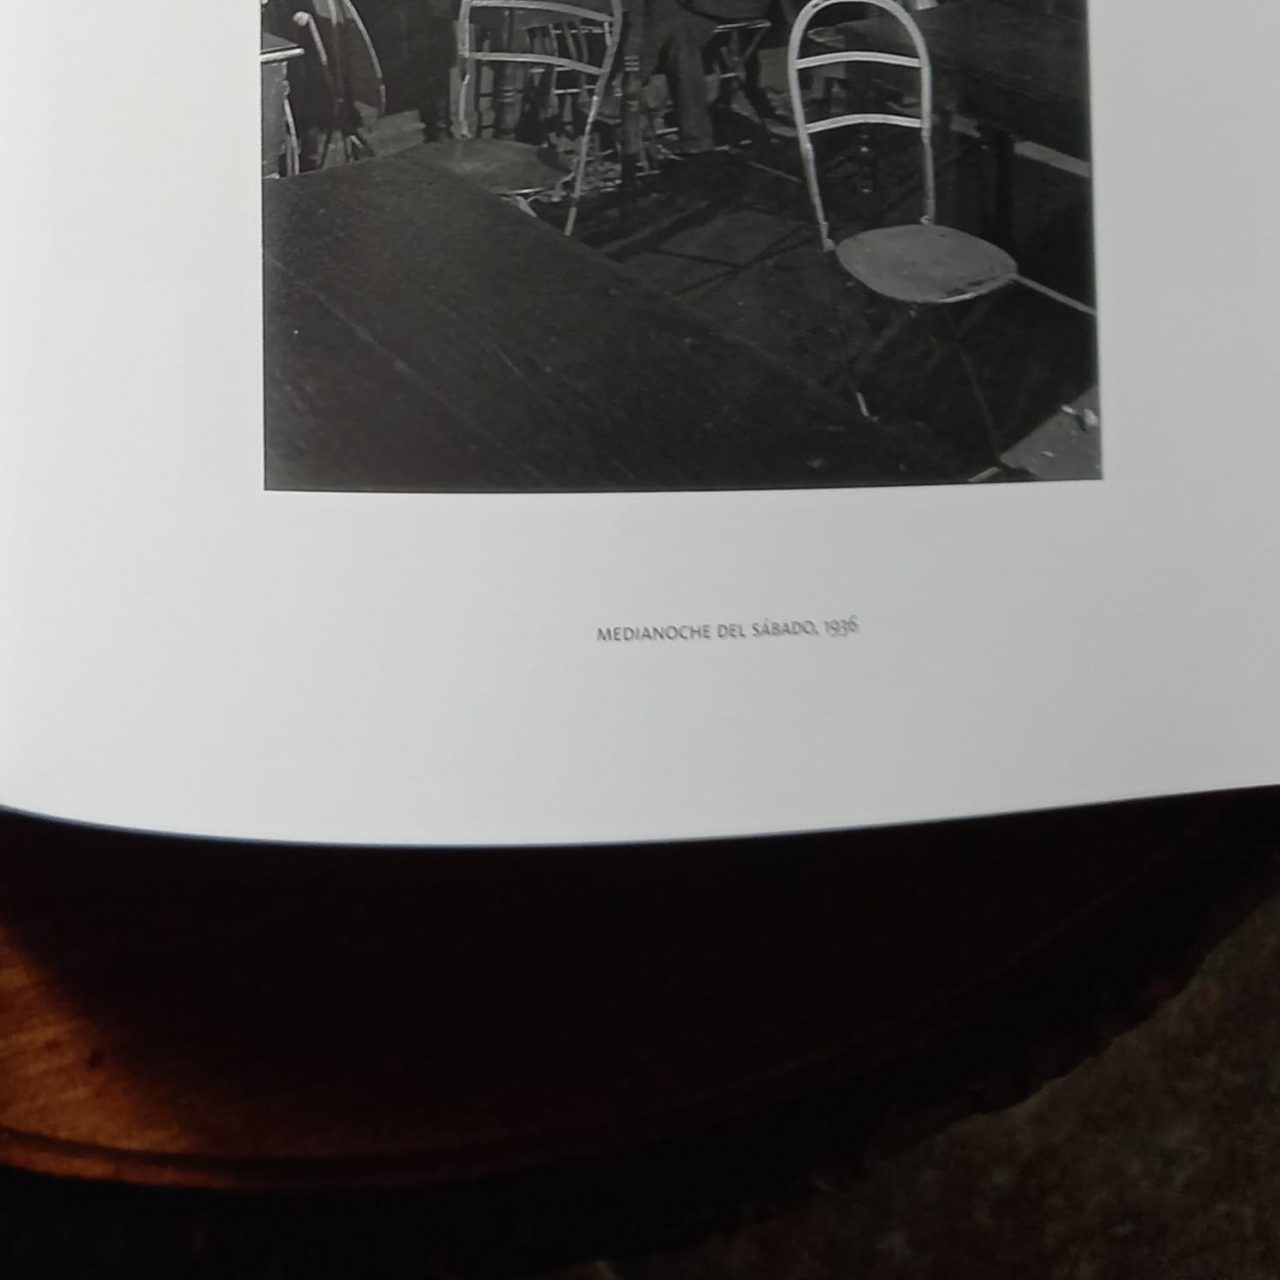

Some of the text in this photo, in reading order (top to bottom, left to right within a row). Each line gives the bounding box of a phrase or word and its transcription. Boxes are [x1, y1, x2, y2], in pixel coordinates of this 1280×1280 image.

[596, 614, 861, 642] MEDIANOCHE DEL SÁBADO, 1936
